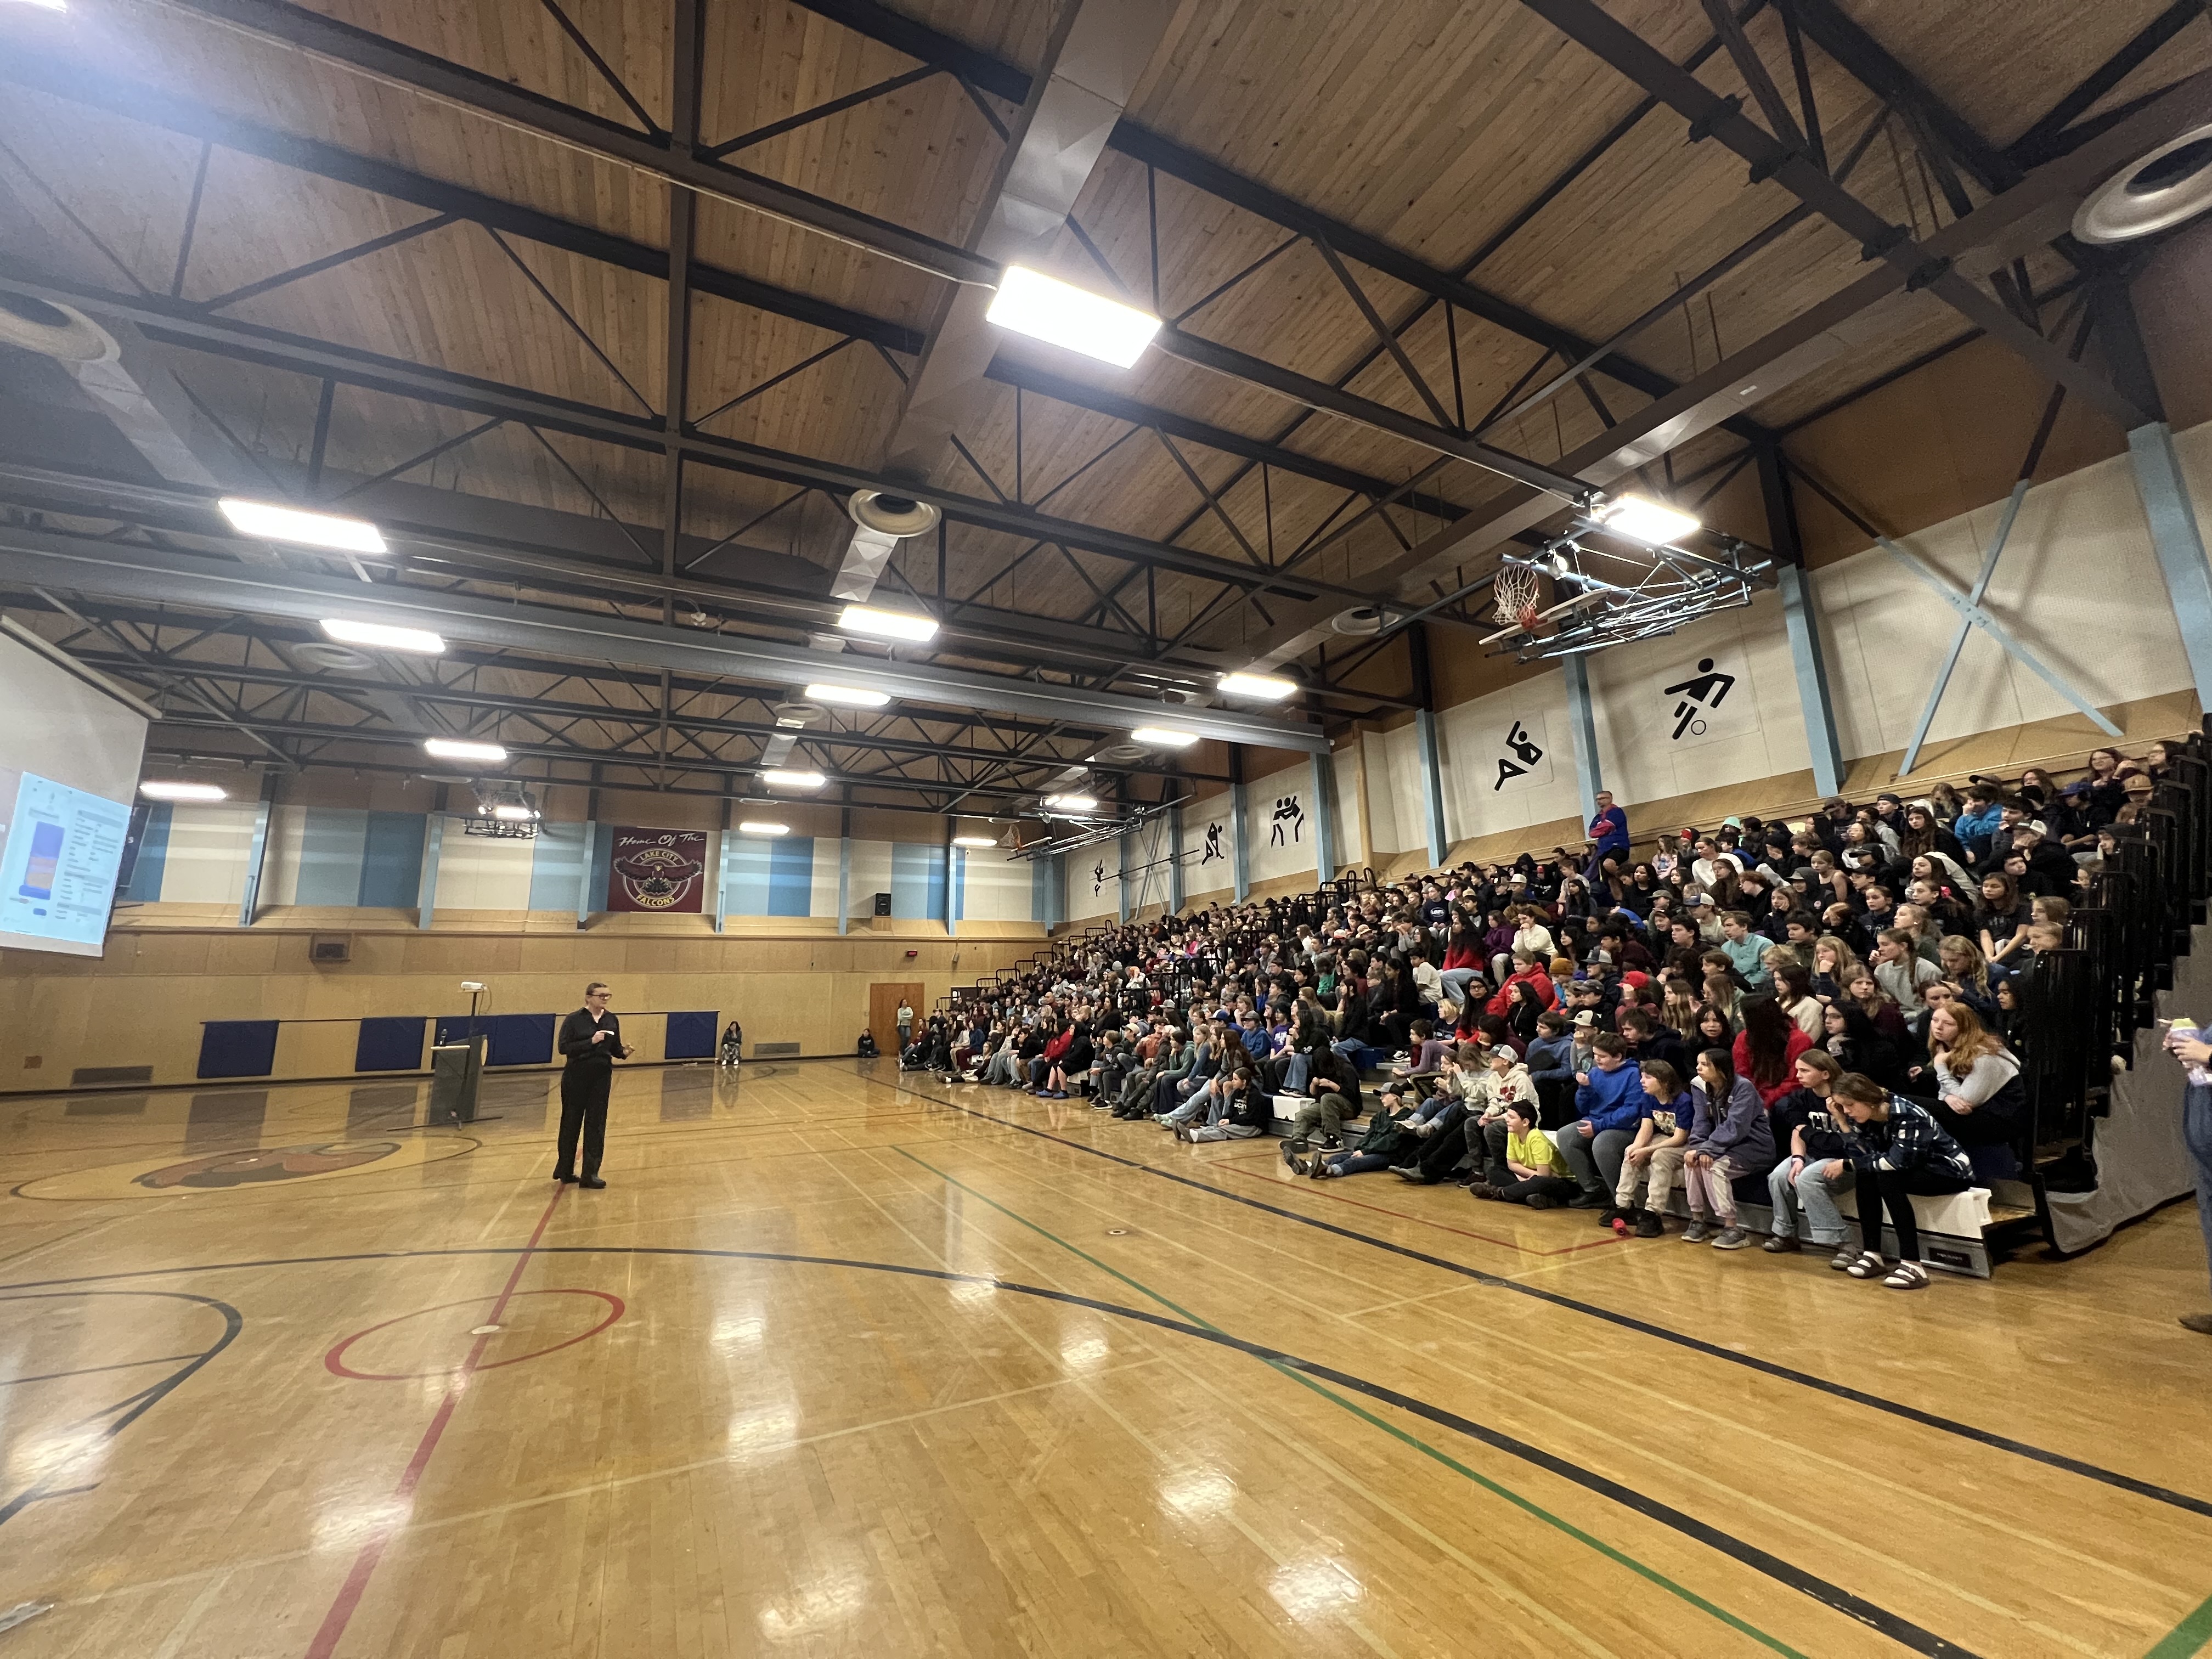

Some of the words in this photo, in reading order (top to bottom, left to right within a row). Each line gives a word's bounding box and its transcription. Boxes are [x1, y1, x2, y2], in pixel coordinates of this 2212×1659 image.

[618, 837, 656, 847] Home
[658, 834, 677, 847] Of
[679, 832, 705, 844] The
[639, 851, 660, 861] LAKE
[661, 851, 679, 861] CITY
[636, 894, 675, 906] FALCONS
